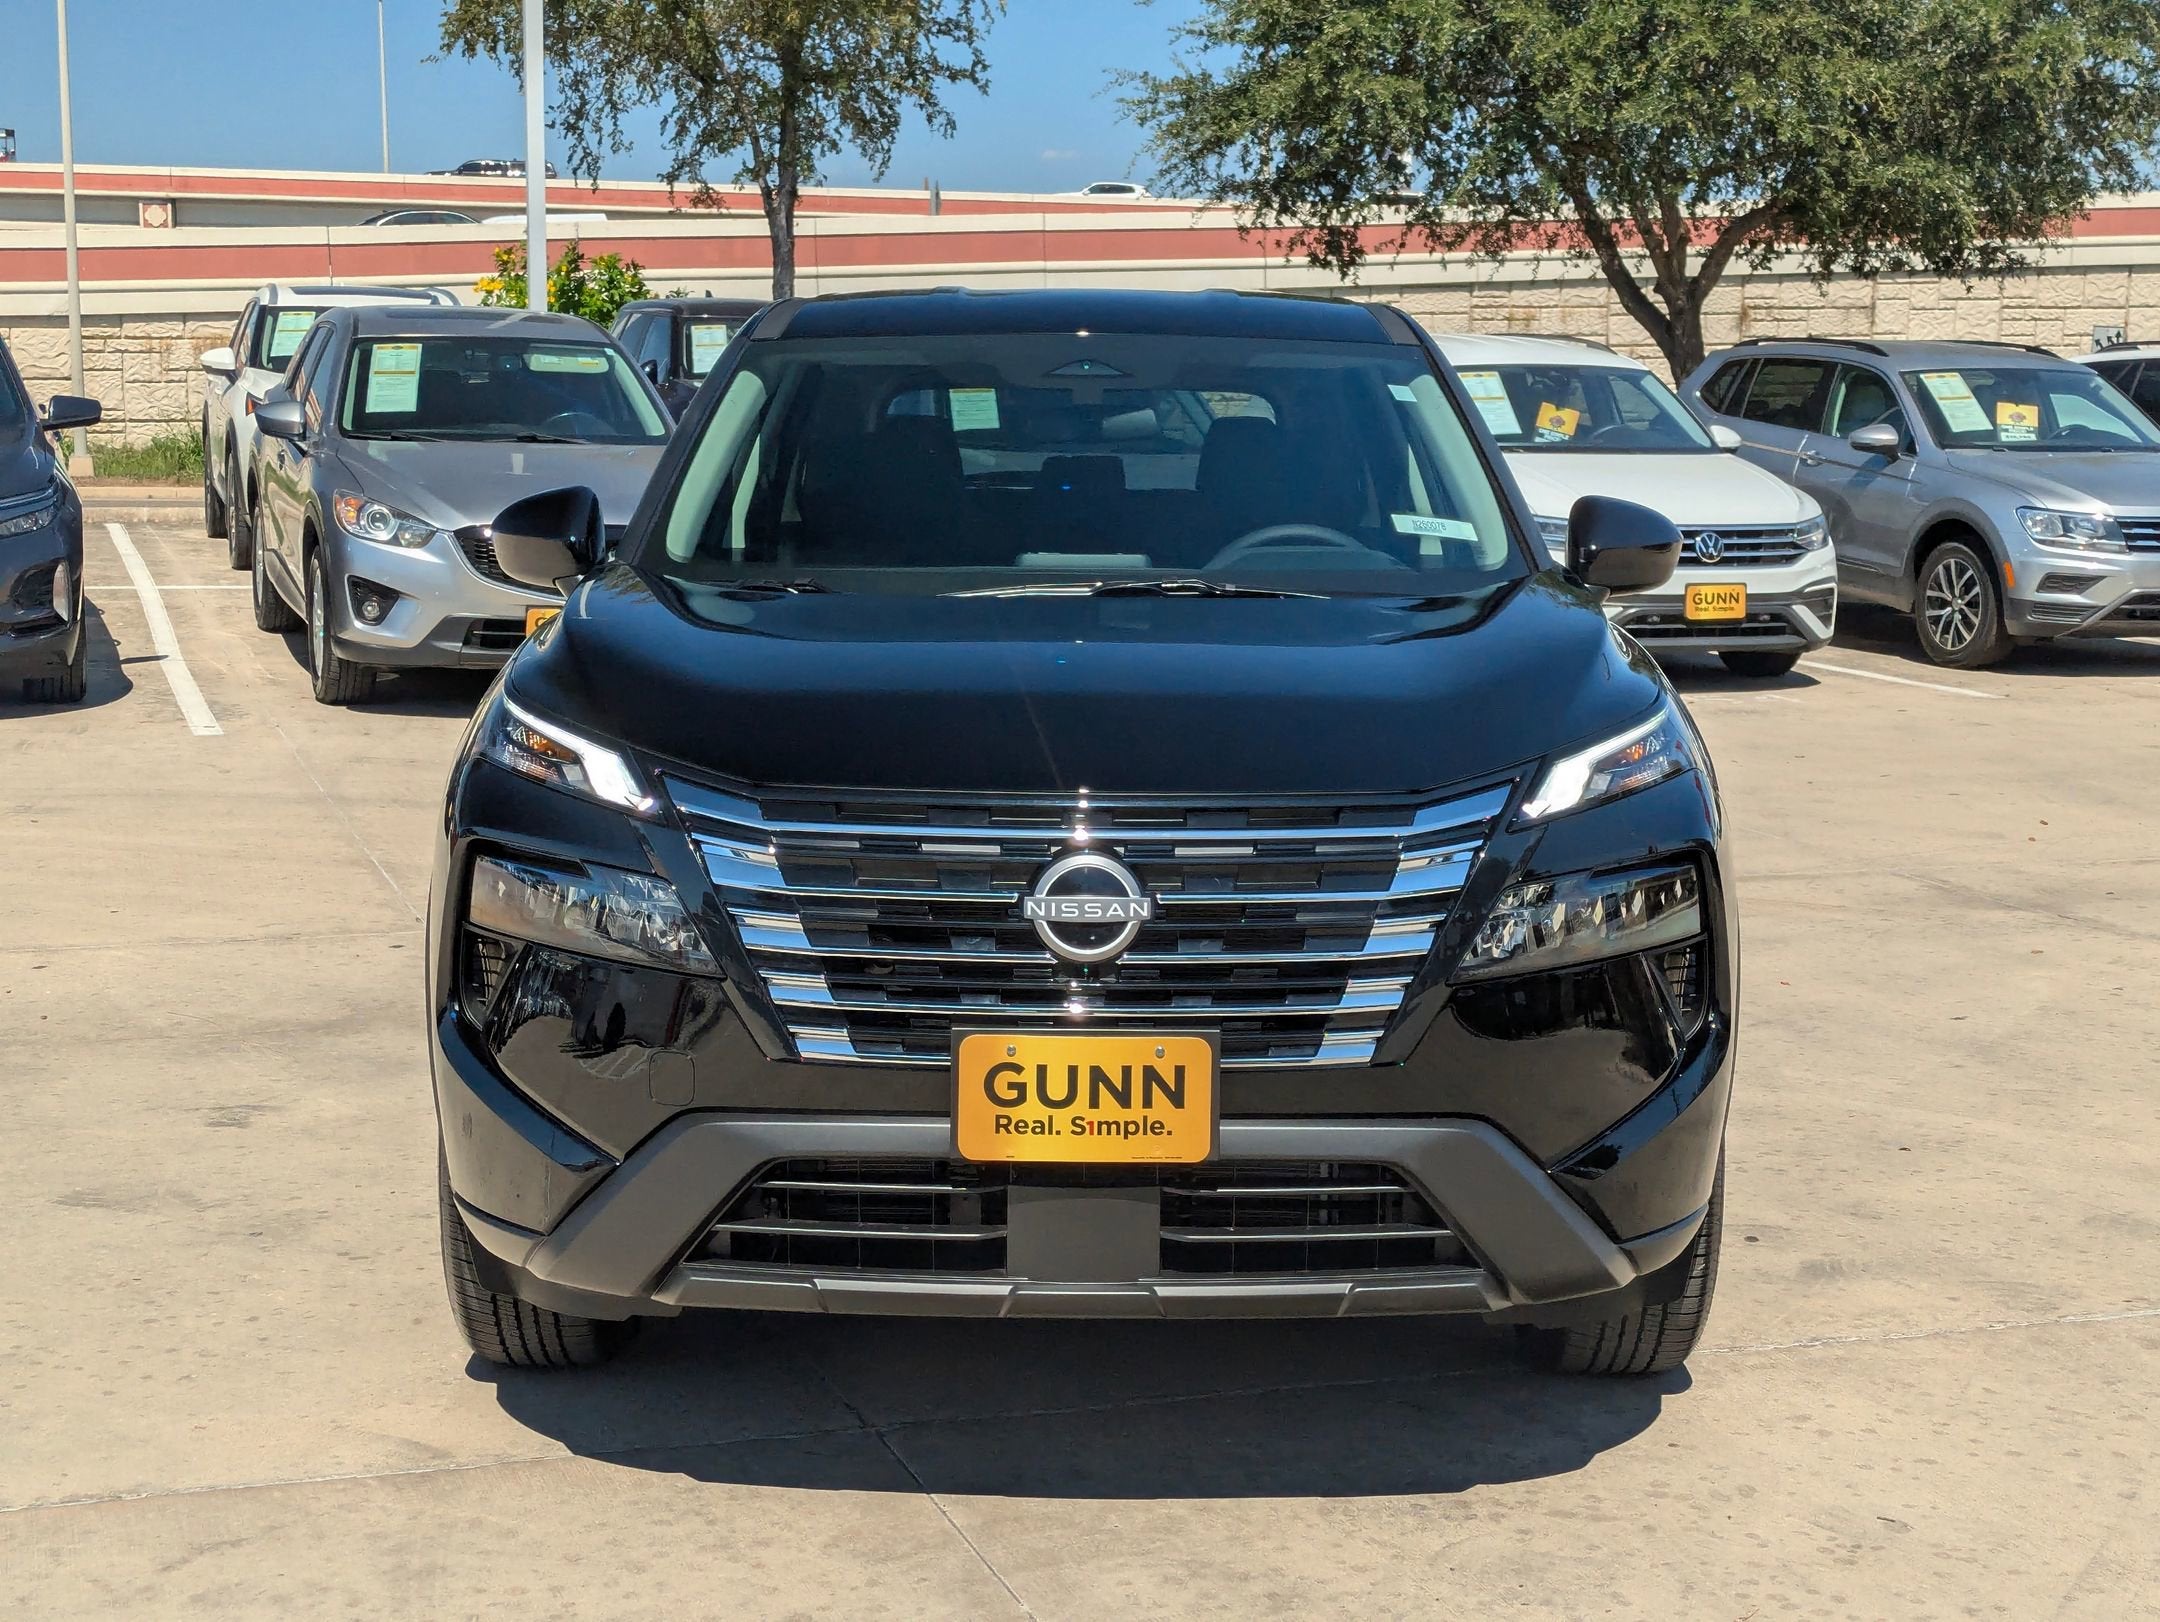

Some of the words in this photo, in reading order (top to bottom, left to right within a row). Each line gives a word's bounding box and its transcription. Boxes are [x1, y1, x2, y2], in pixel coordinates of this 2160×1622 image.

[1692, 592, 1740, 605] GUNN
[1026, 901, 1148, 918] NISSAN
[983, 1061, 1186, 1110] GUNN
[994, 1114, 1061, 1136] Real.
